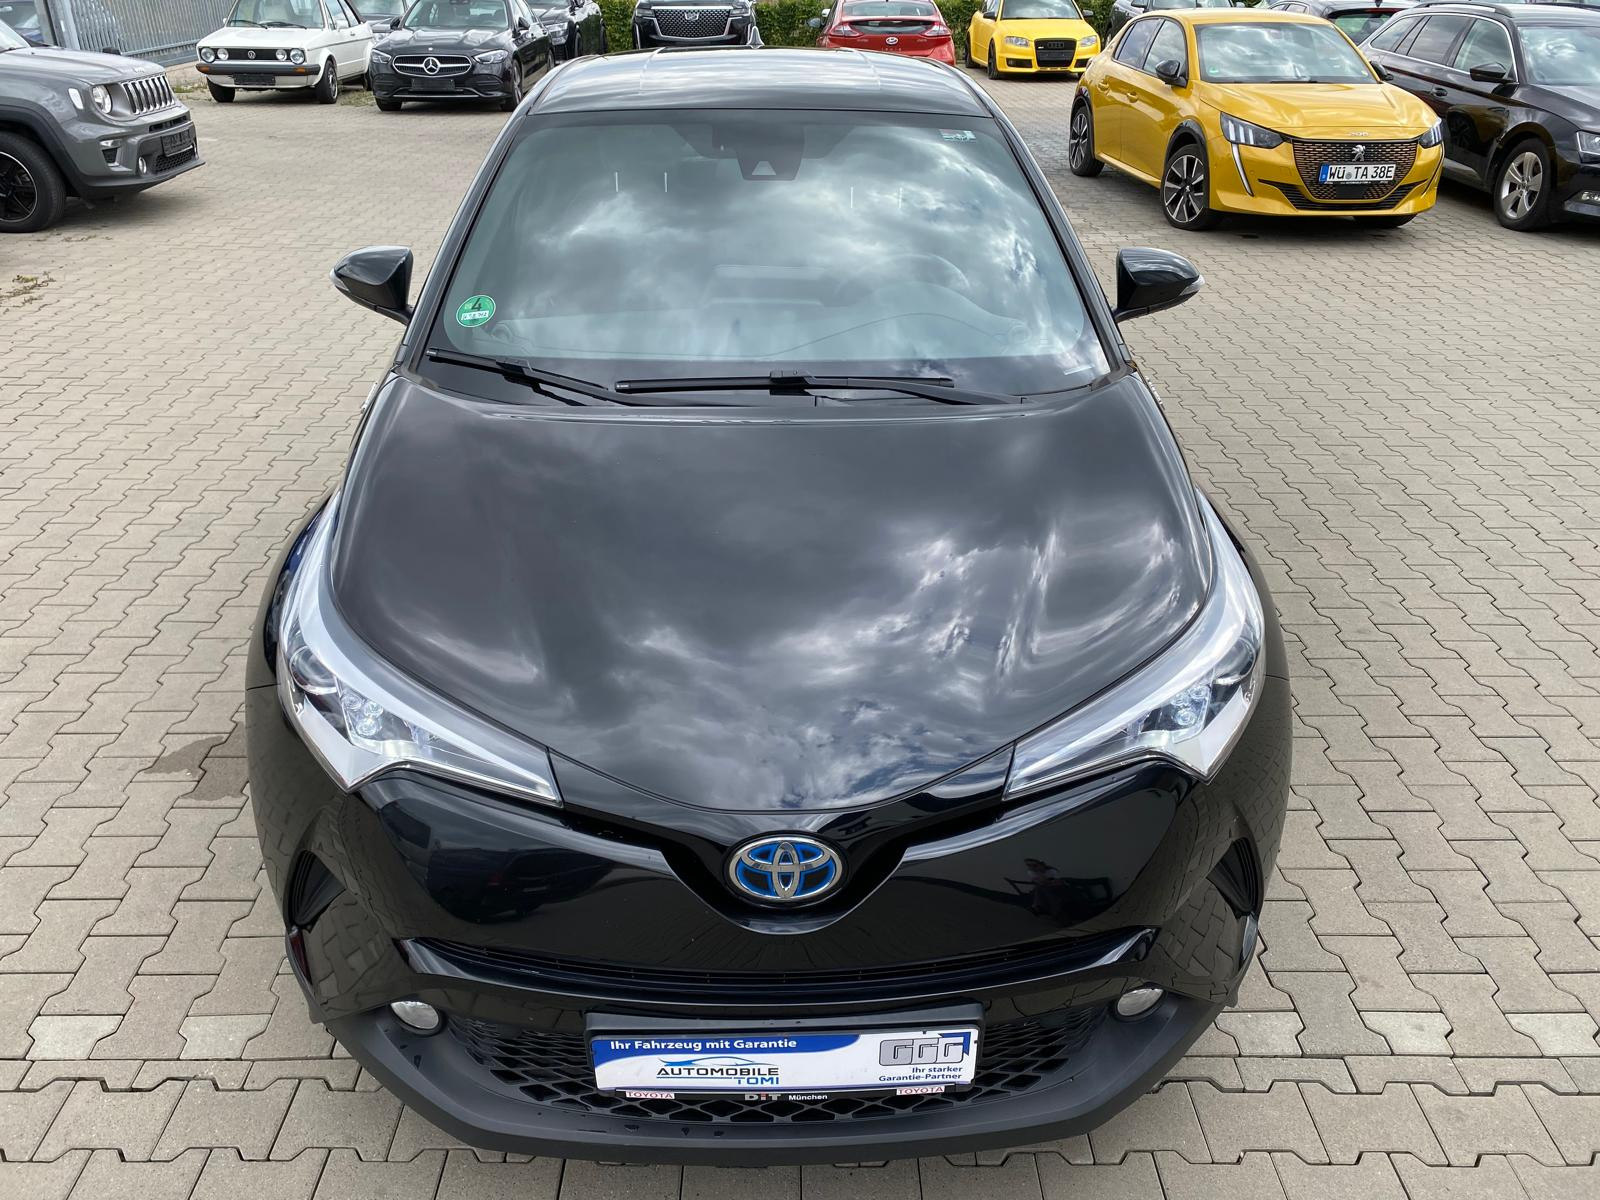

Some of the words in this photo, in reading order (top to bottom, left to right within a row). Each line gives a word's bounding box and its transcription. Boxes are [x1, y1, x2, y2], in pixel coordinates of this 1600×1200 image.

[1328, 166, 1346, 179] WÜ
[1354, 166, 1368, 179] TA
[1371, 166, 1394, 178] 38E
[471, 297, 482, 311] 4
[610, 1041, 631, 1050] Ihr
[634, 1040, 702, 1051] Fahrzeug
[705, 1040, 731, 1049] mit
[733, 1038, 797, 1049] Garantie
[656, 1067, 780, 1076] AUTOMOBILE
[737, 1076, 780, 1085] TOMI
[878, 1073, 963, 1082] Garantie-Partner
[628, 1091, 674, 1099] TOYOTA
[899, 1086, 944, 1095] TOYOTA
